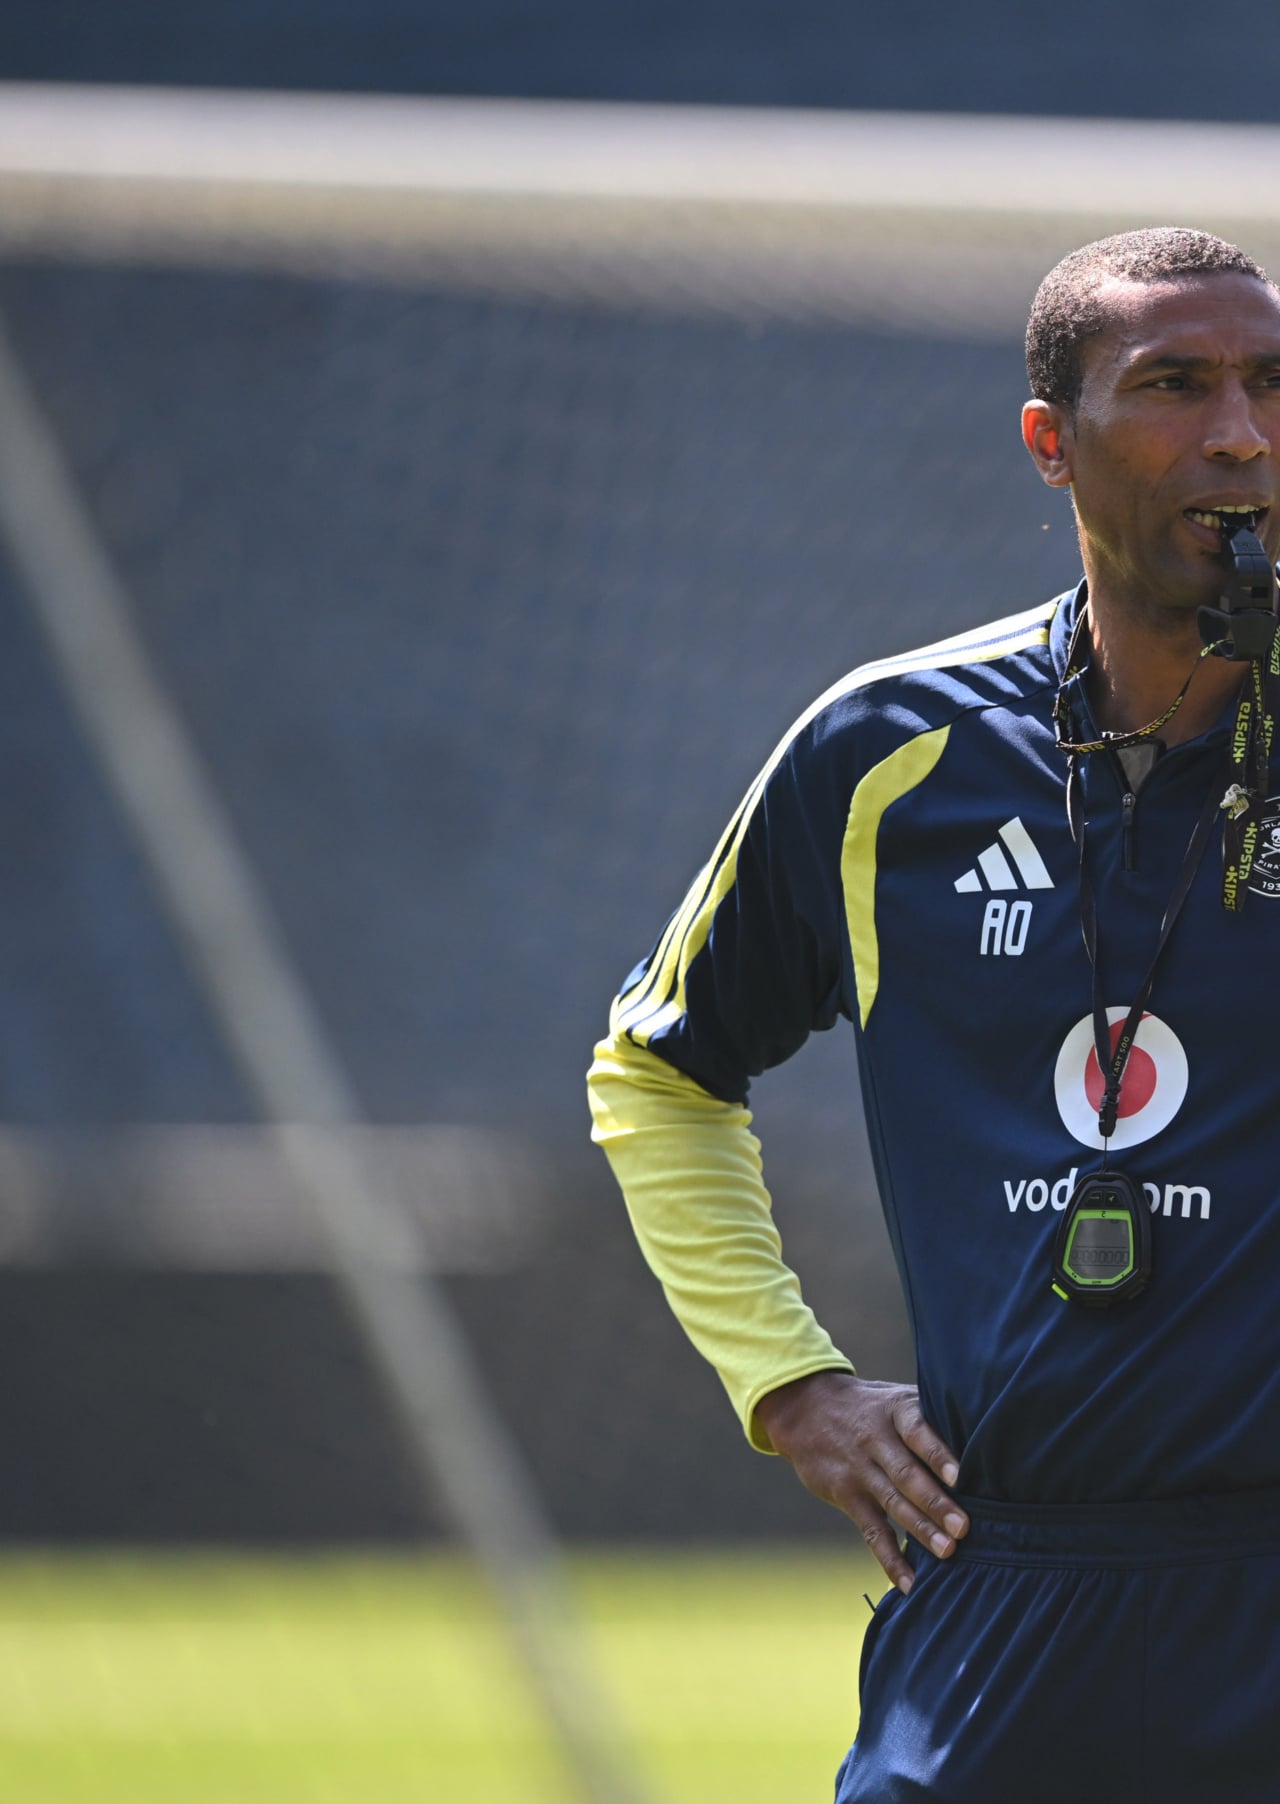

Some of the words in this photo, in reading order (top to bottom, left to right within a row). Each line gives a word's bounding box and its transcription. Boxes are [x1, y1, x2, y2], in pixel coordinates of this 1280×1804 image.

[1233, 702, 1251, 758] KIPSTA
[1239, 827, 1258, 880] KIPSTA
[980, 899, 1033, 956] AO
[1003, 1167, 1211, 1219] vodom
